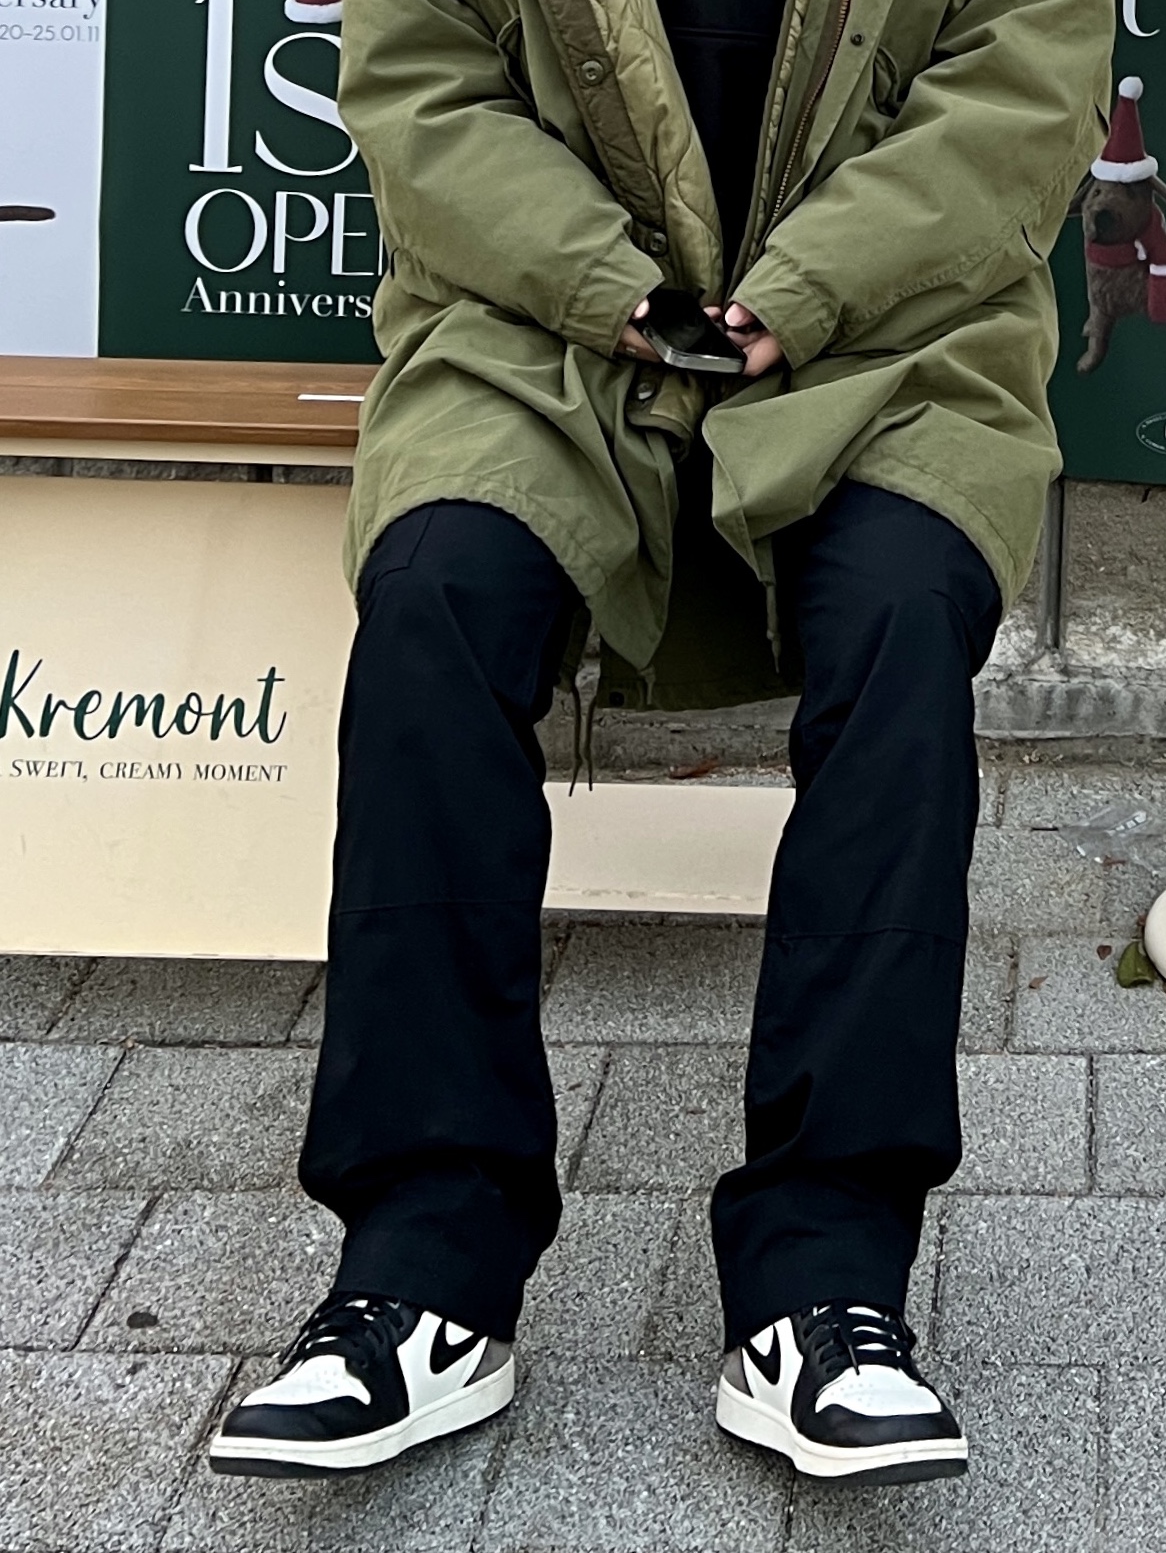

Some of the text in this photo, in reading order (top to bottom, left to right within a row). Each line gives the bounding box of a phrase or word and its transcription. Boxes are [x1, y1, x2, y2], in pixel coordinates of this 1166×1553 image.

[184, 187, 385, 277] OPE
[180, 277, 373, 318] Annivers
[0, 649, 288, 744] Kremont
[193, 762, 288, 783] MOMENT
